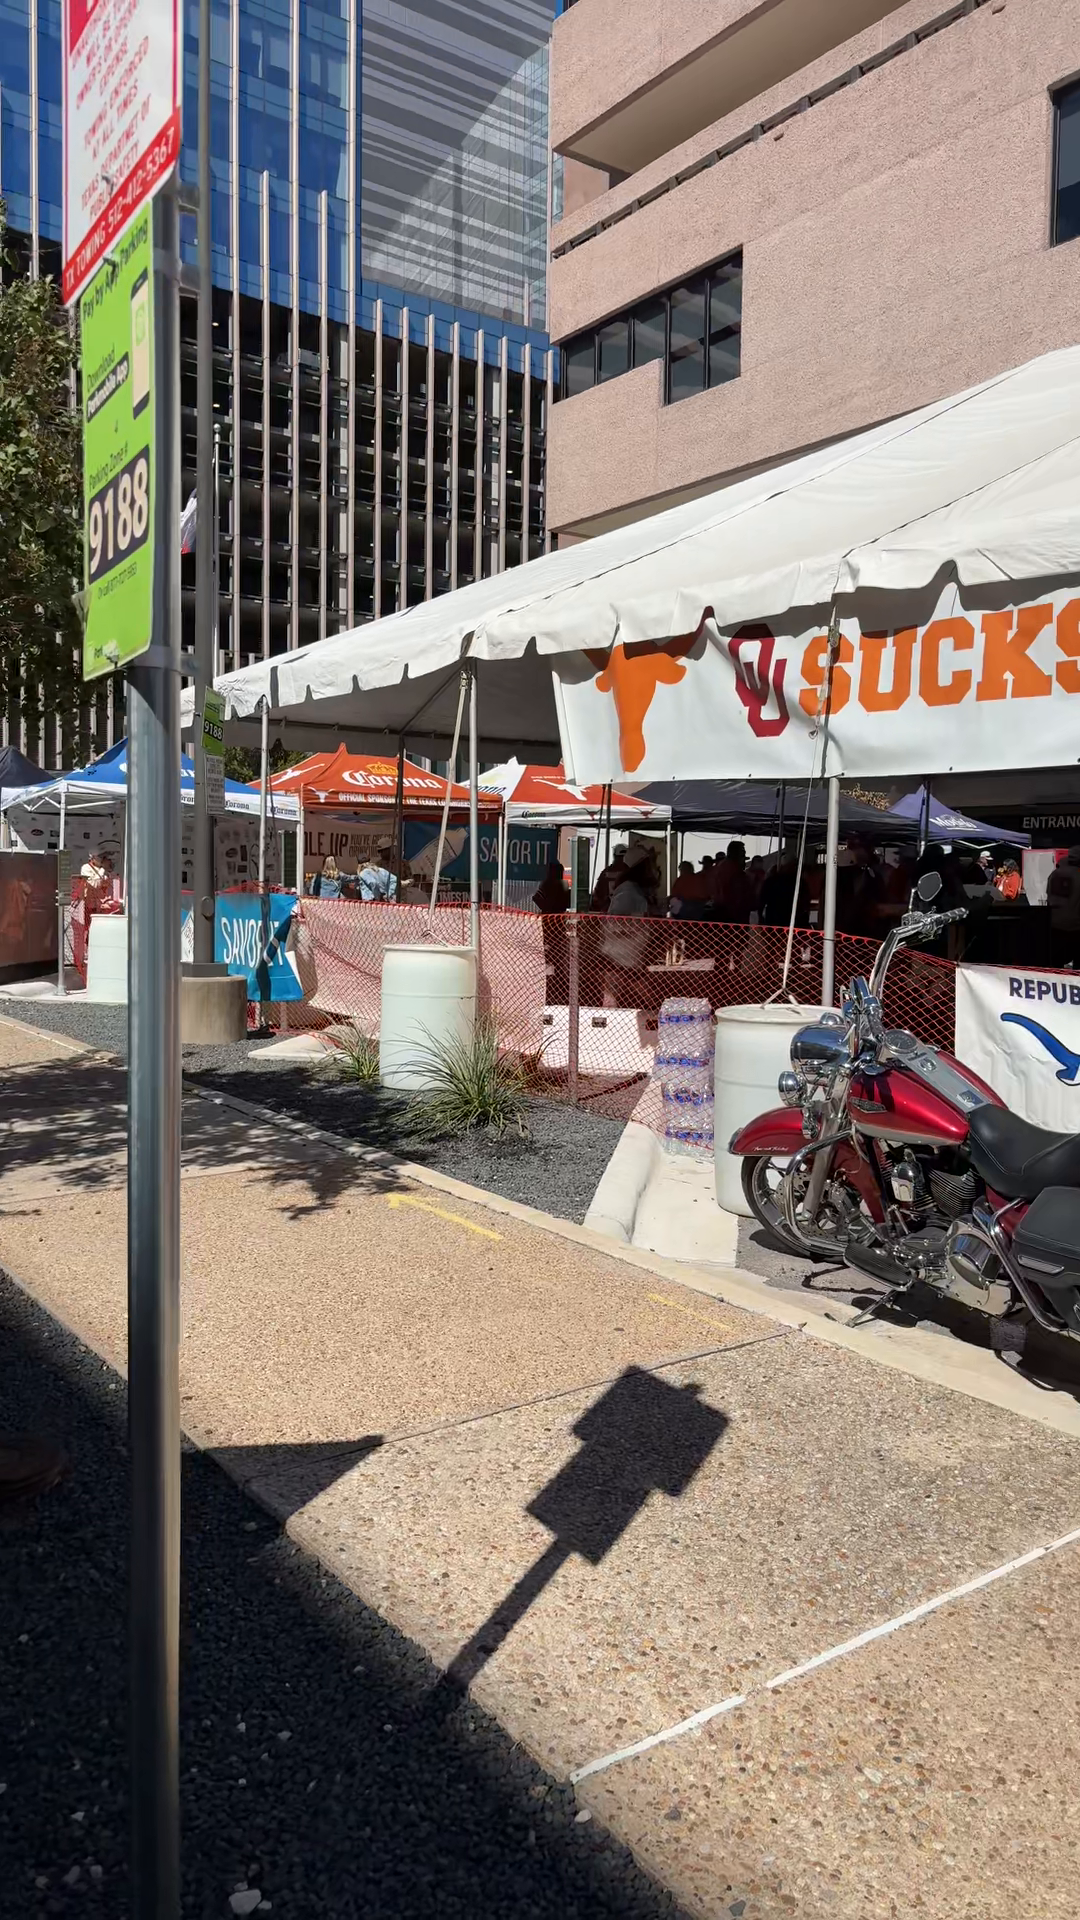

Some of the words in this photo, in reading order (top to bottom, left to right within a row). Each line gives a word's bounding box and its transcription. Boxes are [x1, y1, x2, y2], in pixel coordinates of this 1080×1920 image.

[84, 101, 107, 150] TOWING
[110, 35, 148, 109] ENFORCED
[101, 123, 114, 149] ALL
[116, 78, 138, 121] TIMES
[113, 140, 139, 188] SAFETY
[81, 173, 99, 212] TEXAS
[65, 269, 75, 292] TX
[77, 226, 106, 276] TOWING
[107, 125, 175, 233] 512-412-5367
[82, 296, 95, 322] Pay
[95, 283, 104, 306] by
[120, 217, 148, 270] Parking
[87, 344, 115, 393] Download
[116, 359, 128, 387] App
[109, 446, 125, 477] Zone
[90, 457, 148, 575] 9188
[204, 720, 223, 740] 9188
[342, 769, 442, 789] Corna
[225, 800, 249, 810] Corona
[270, 806, 297, 817] Corona
[338, 792, 366, 803] OFFICIAL
[406, 797, 417, 805] THE
[418, 798, 437, 806] TEXAS
[521, 810, 546, 819] Corona
[330, 832, 348, 858] UP
[536, 841, 551, 865] IT
[1009, 977, 1080, 1006] REPUB
